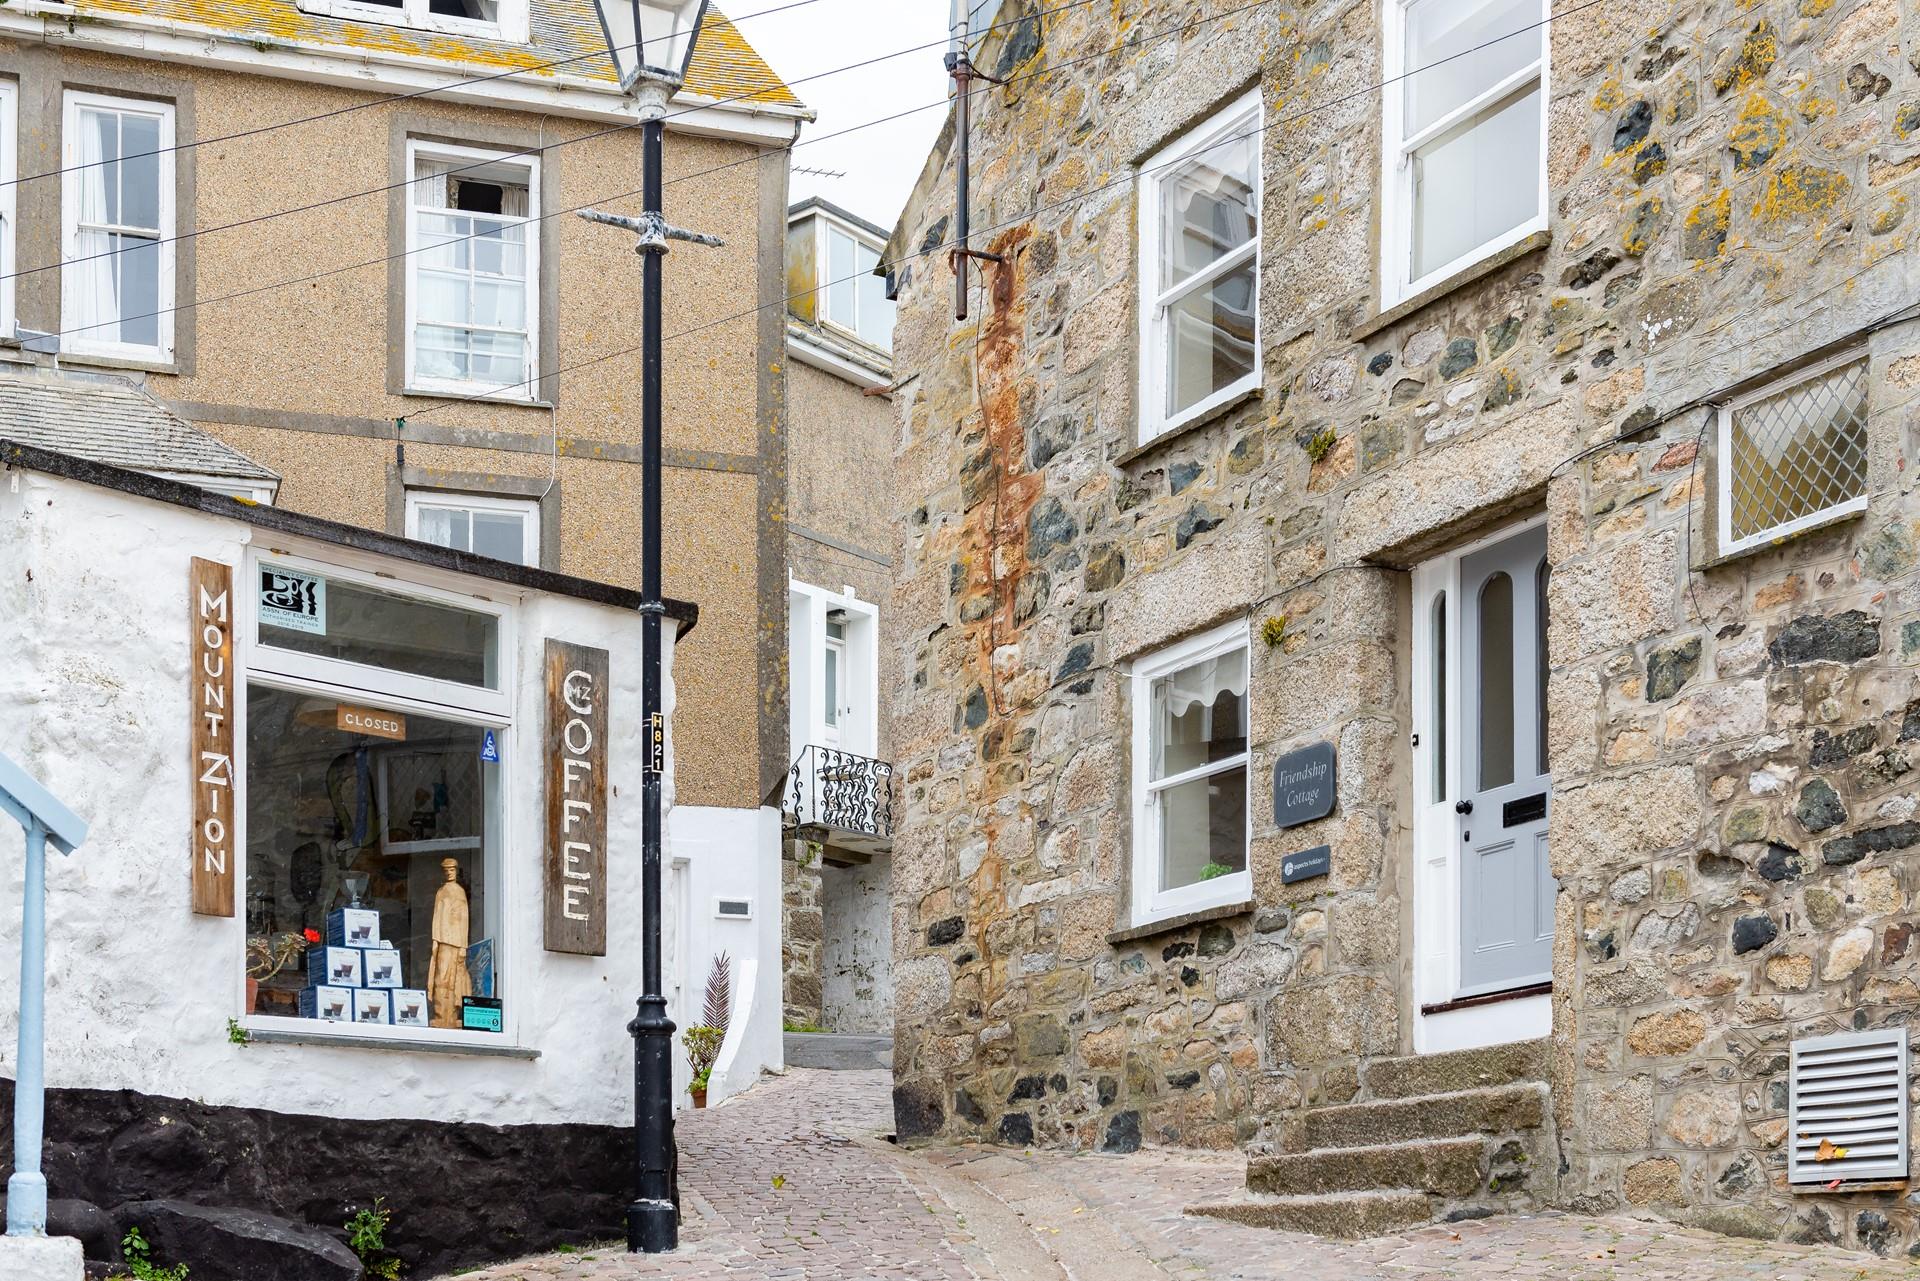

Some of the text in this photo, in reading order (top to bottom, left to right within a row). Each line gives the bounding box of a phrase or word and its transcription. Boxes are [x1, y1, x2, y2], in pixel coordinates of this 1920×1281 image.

[295, 572, 319, 582] COFFEE
[293, 613, 319, 623] EUROPE
[199, 583, 228, 738] MOUNT
[345, 713, 399, 733] CLOSED
[653, 715, 662, 771] H821
[1280, 761, 1327, 788] Friendship
[563, 669, 593, 921] COFFEE
[1287, 787, 1320, 807] Cottage
[199, 751, 229, 874] ZION
